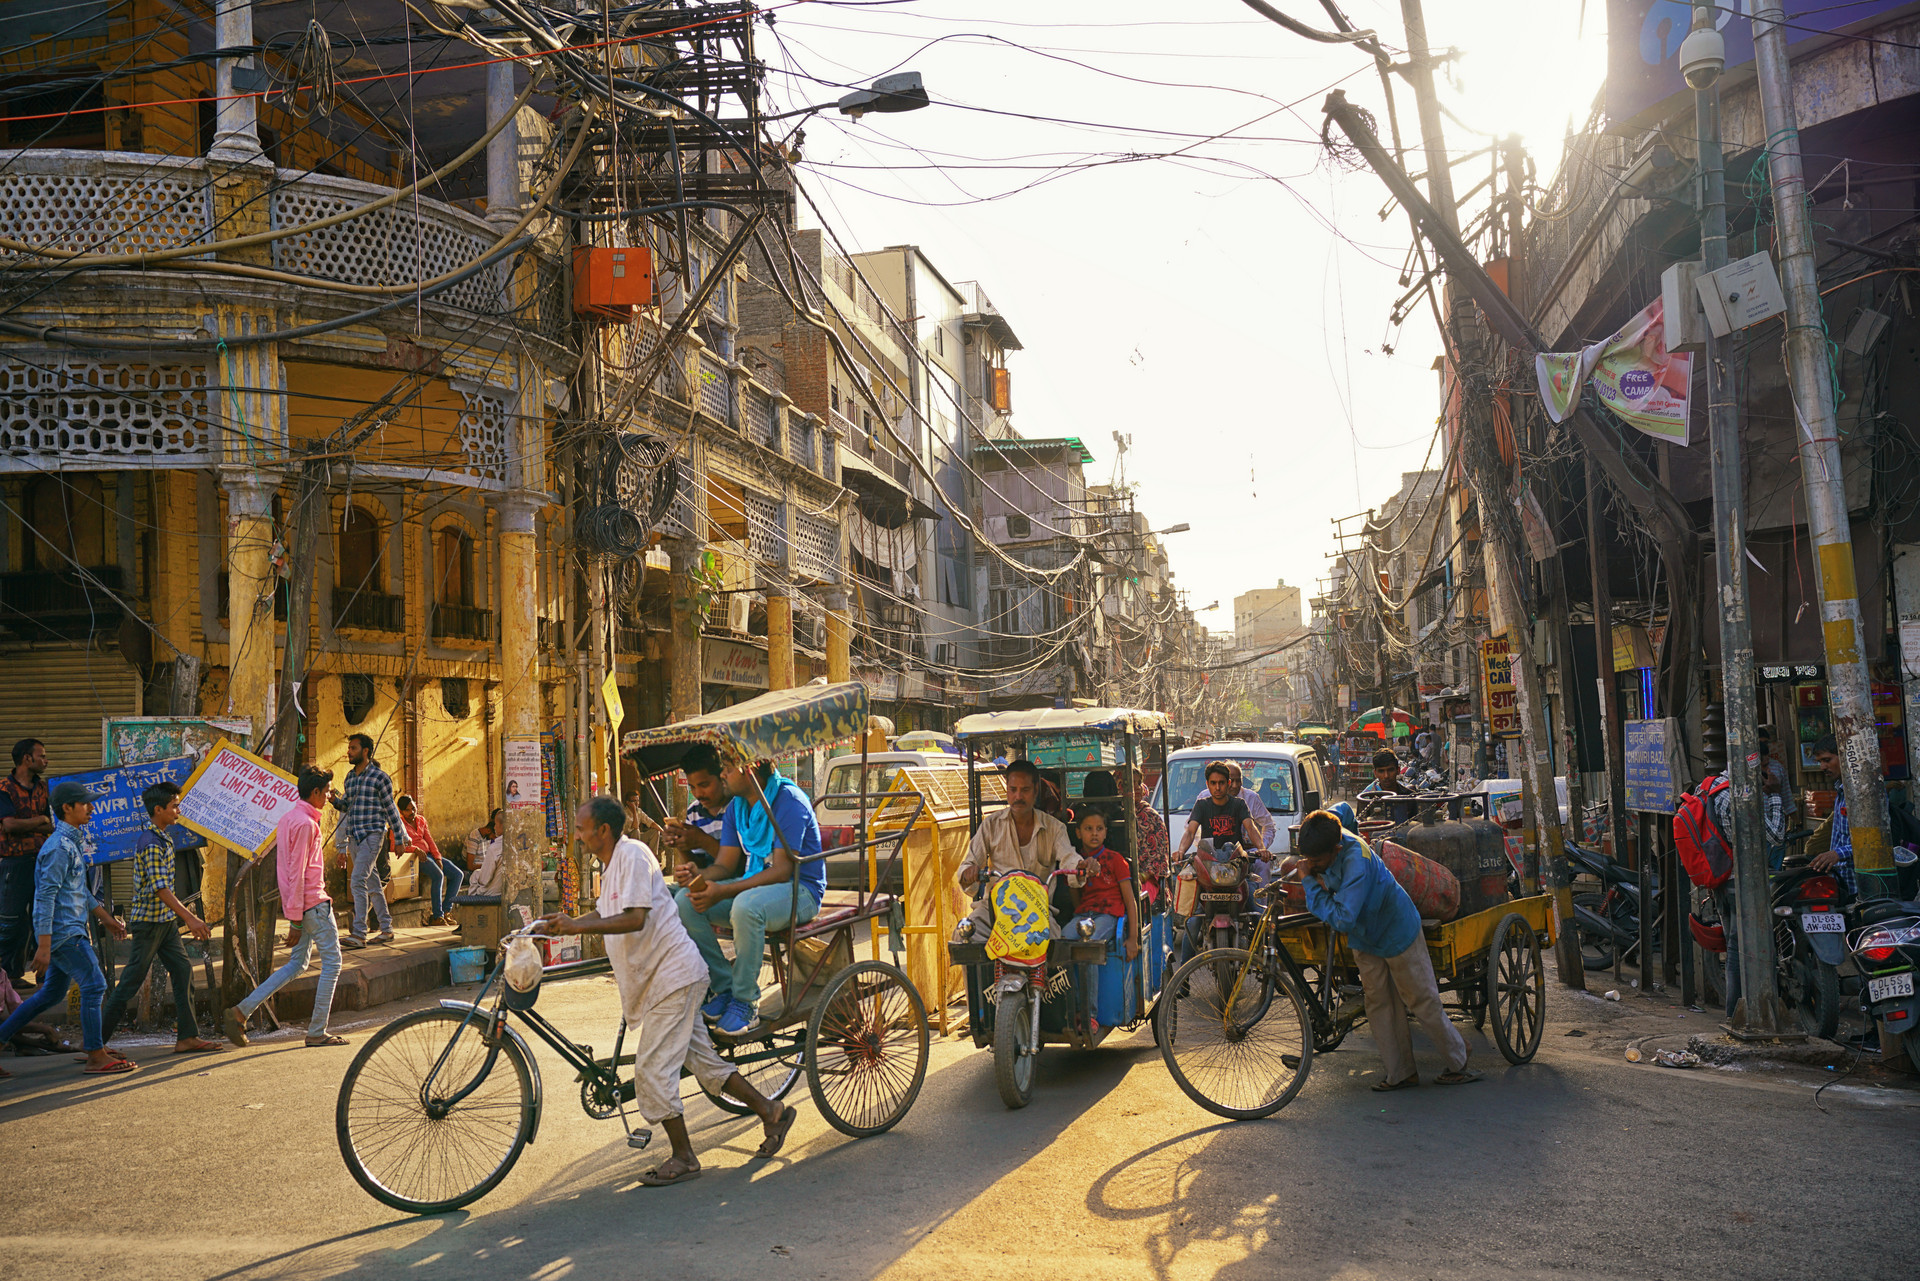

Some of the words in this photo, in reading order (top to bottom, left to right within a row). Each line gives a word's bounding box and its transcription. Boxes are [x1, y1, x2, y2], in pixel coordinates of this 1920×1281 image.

[1626, 373, 1648, 382] FREE
[1624, 385, 1650, 396] CAMP
[731, 671, 763, 685] Handicrafts
[1489, 671, 1511, 685] CAR
[215, 751, 250, 778] NORTH
[248, 767, 274, 788] DMC
[270, 779, 301, 803] ROAD
[220, 772, 254, 798] LIMIT
[251, 789, 277, 811] END
[92, 797, 129, 816] AWRI
[1874, 983, 1912, 1000] BF1128
